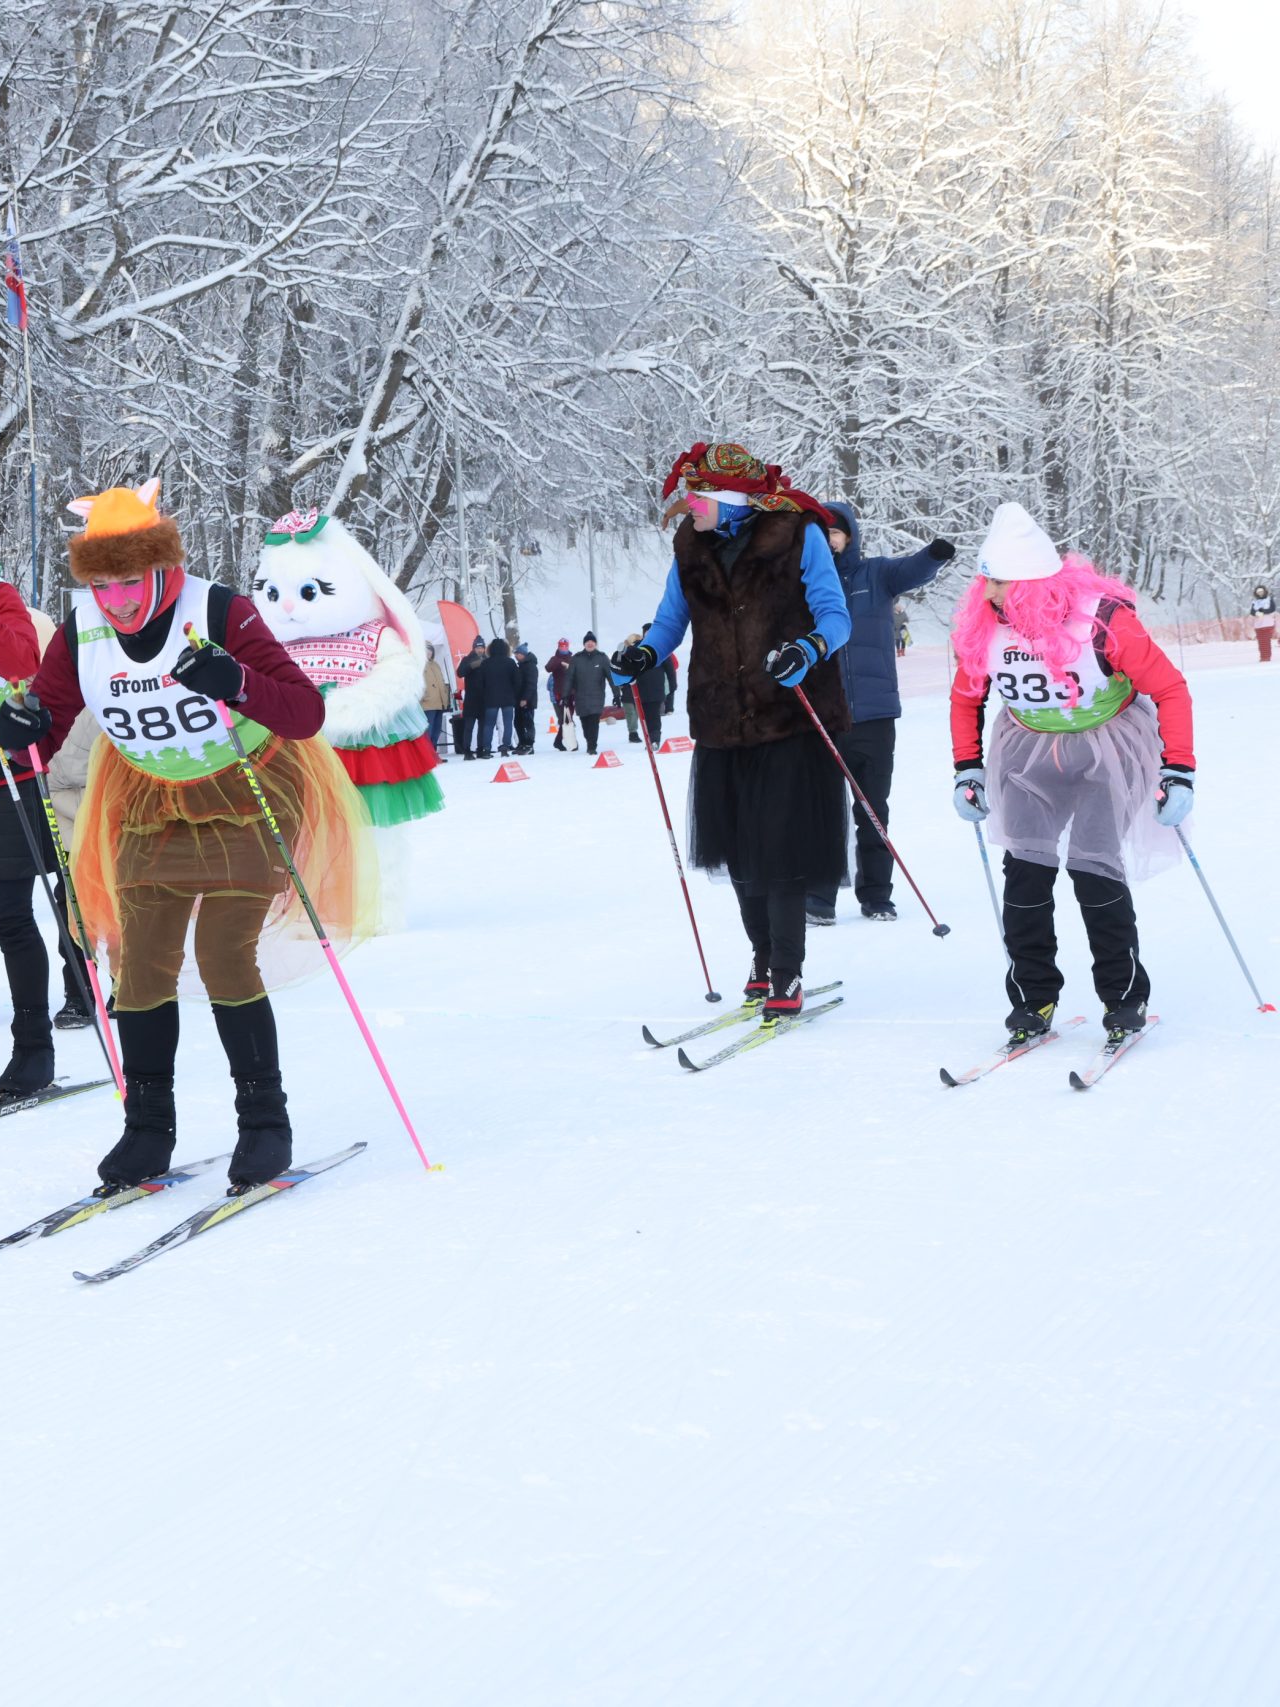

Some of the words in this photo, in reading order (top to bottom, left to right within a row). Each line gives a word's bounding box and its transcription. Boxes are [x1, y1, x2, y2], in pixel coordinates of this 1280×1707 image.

[110, 676, 160, 697] grom
[996, 671, 1085, 703] 333
[102, 695, 218, 741] 386
